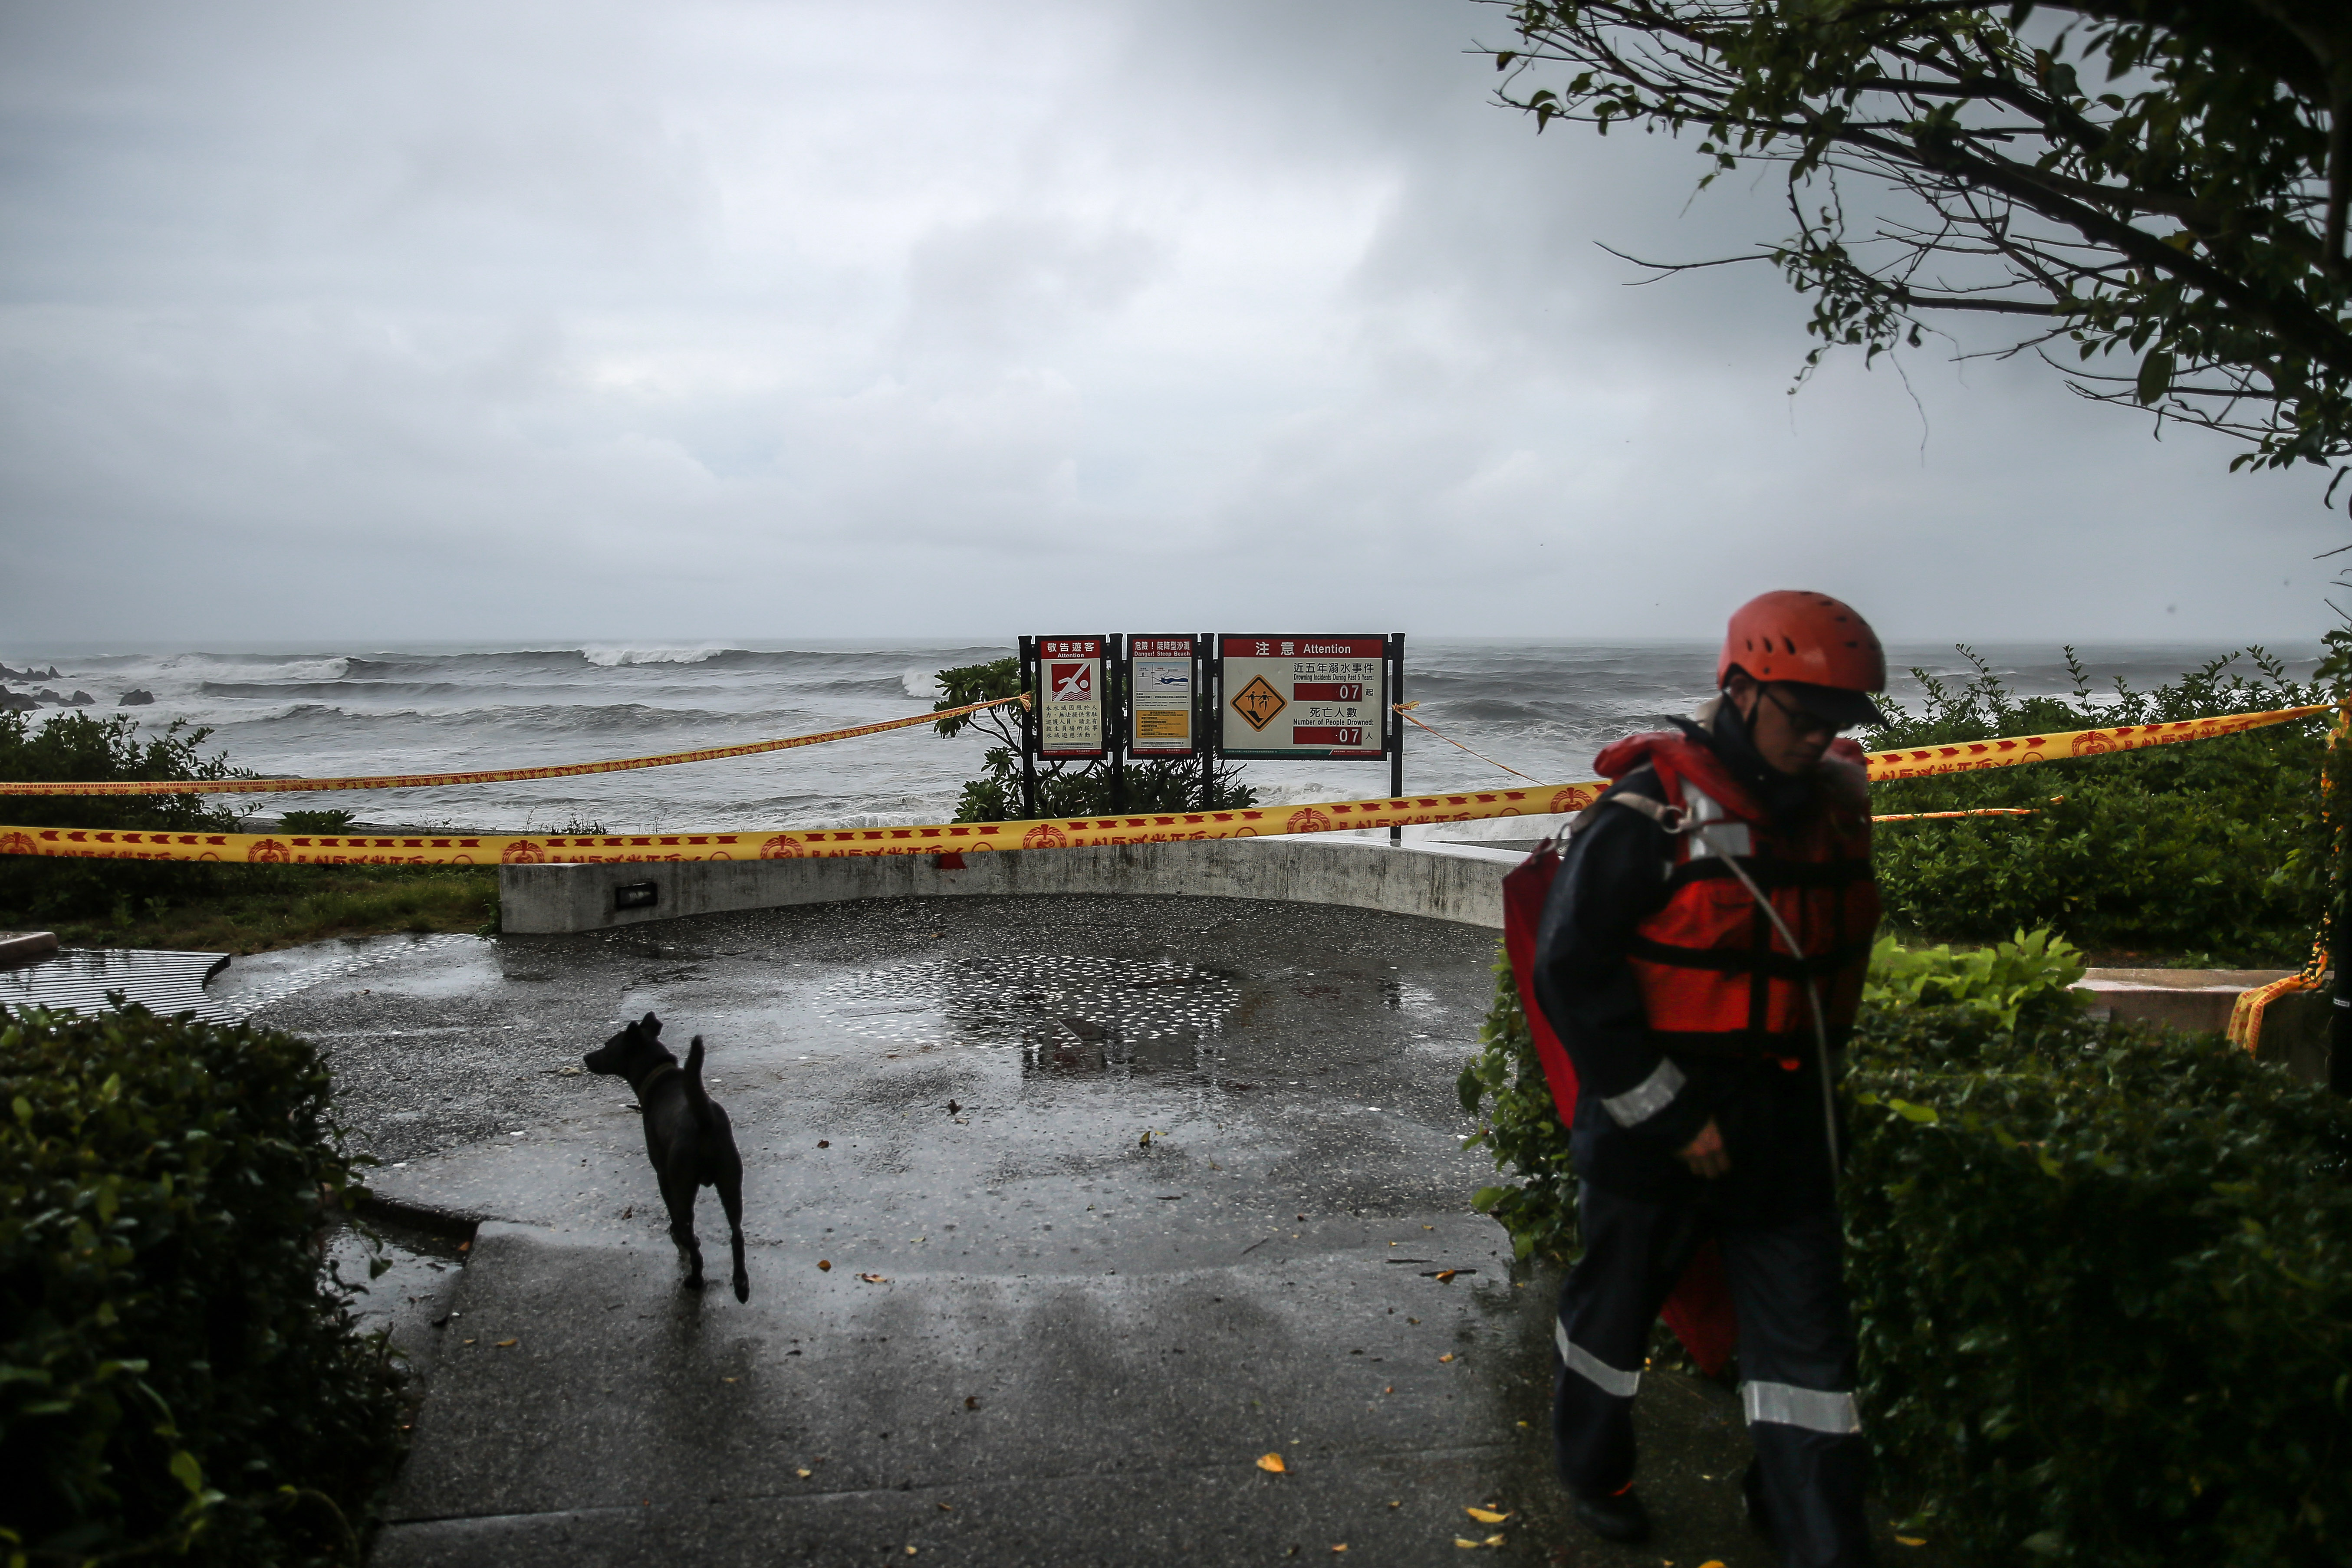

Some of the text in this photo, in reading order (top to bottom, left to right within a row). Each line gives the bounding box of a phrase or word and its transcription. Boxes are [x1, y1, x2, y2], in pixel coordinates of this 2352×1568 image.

[1047, 642, 1094, 652] 敬告遊客
[1303, 644, 1351, 654] Attention
[1293, 662, 1374, 673] 近五年溺水事件
[1340, 685, 1359, 699] 07
[1309, 707, 1357, 718] 死亡人數
[1339, 728, 1359, 743] 07
